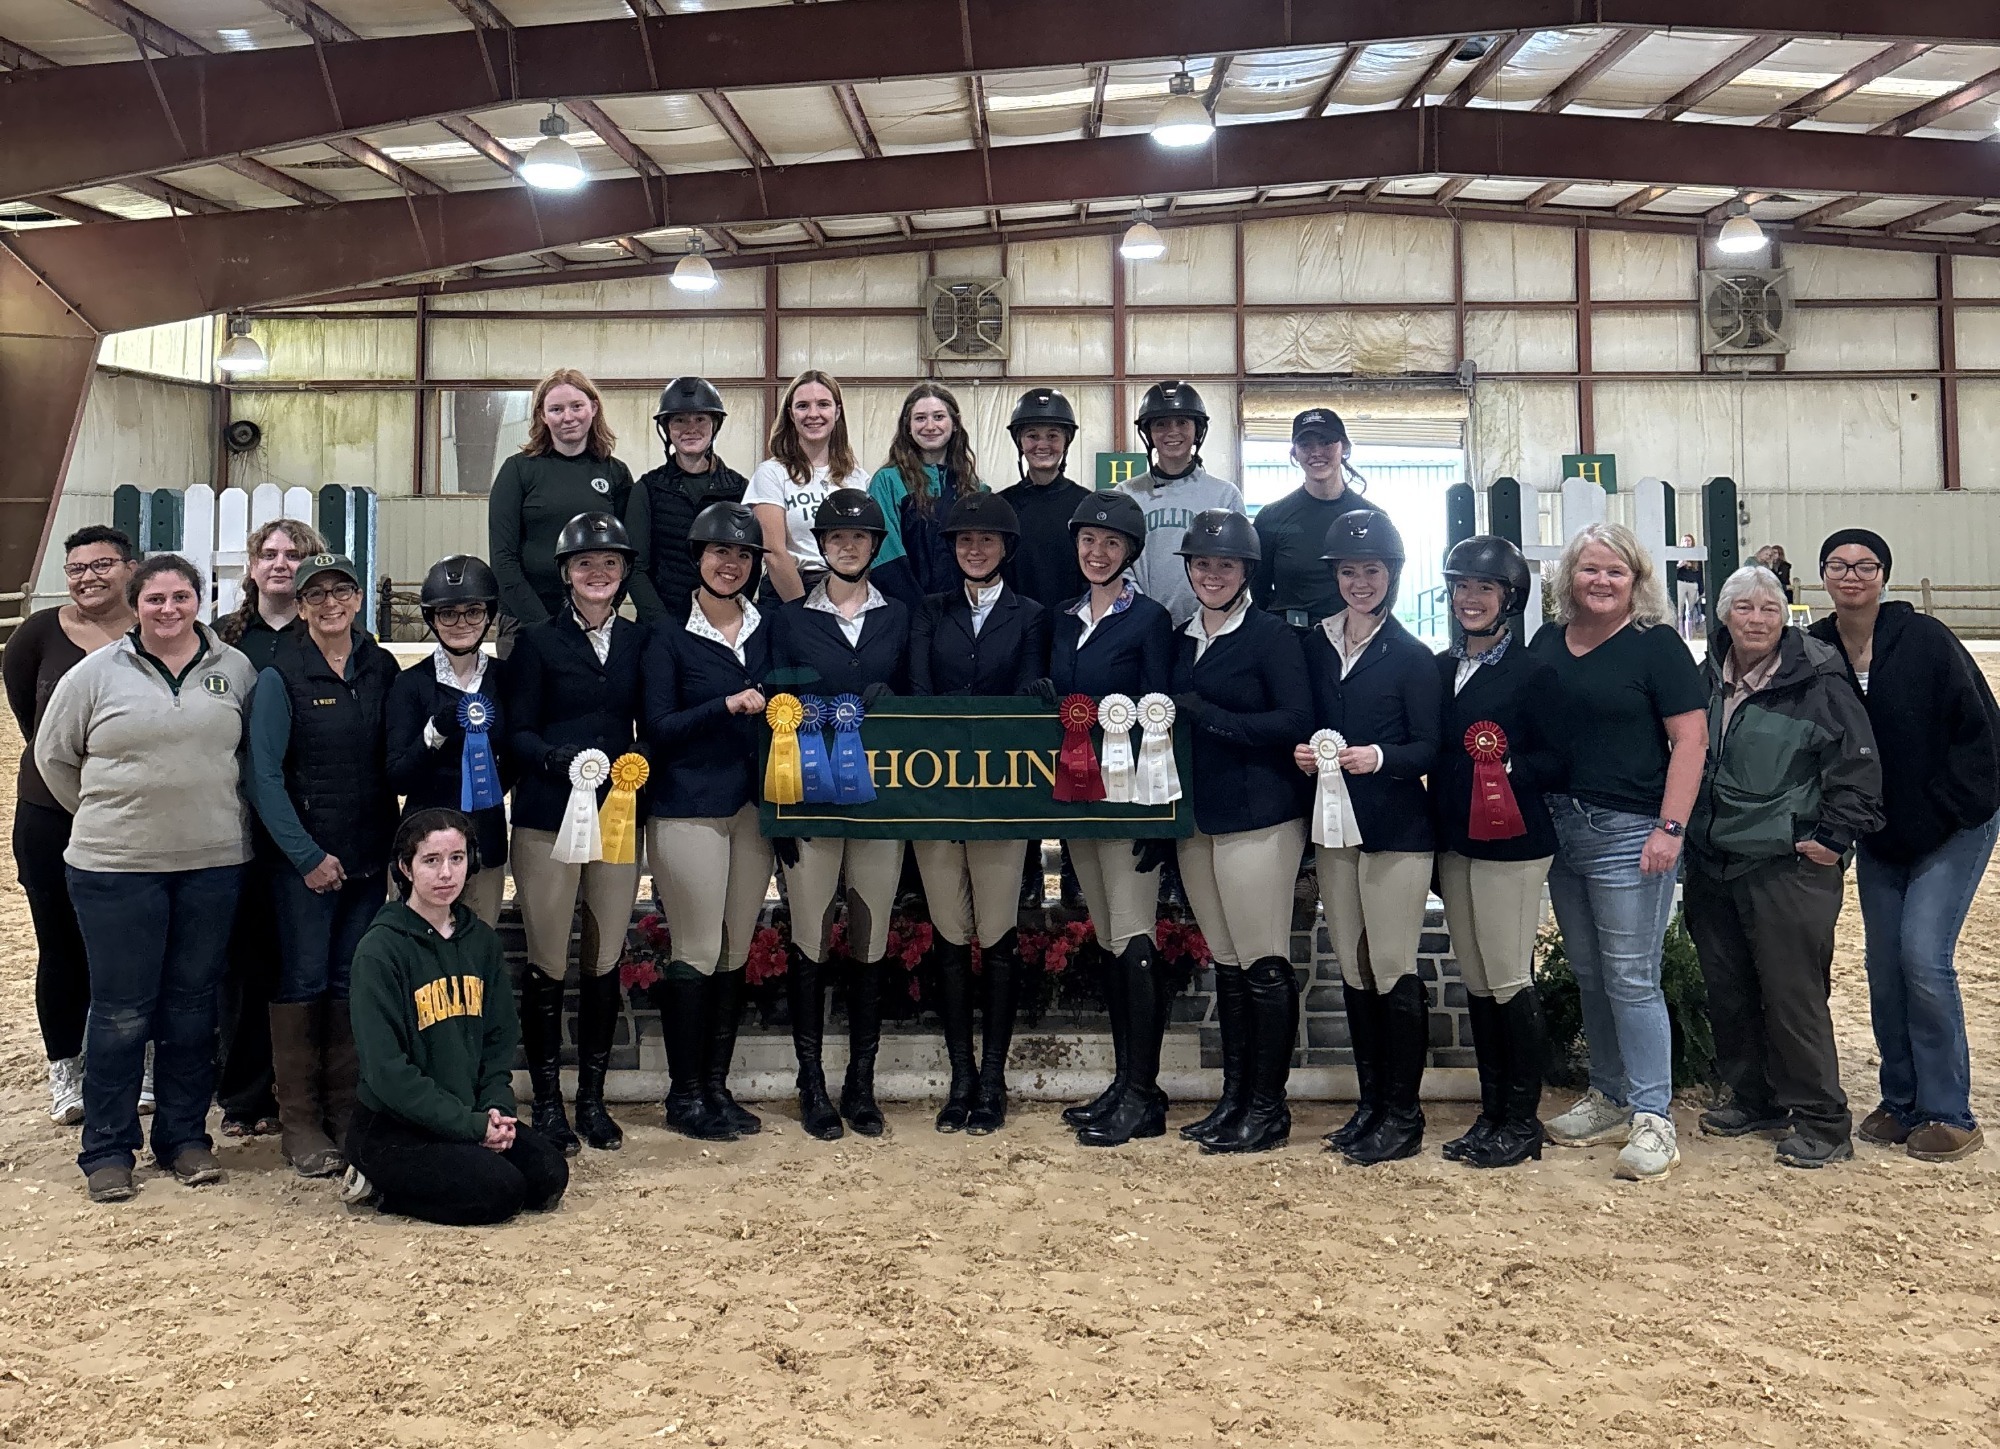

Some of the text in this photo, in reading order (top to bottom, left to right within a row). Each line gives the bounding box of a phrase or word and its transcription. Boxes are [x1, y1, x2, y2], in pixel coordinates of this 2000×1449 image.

[1108, 460, 1134, 484] H
[1576, 462, 1603, 485] H
[1145, 507, 1196, 531] OLLI
[208, 677, 226, 692] H
[864, 748, 1060, 788] HOLLIN
[414, 975, 484, 1031] HOLLIN
